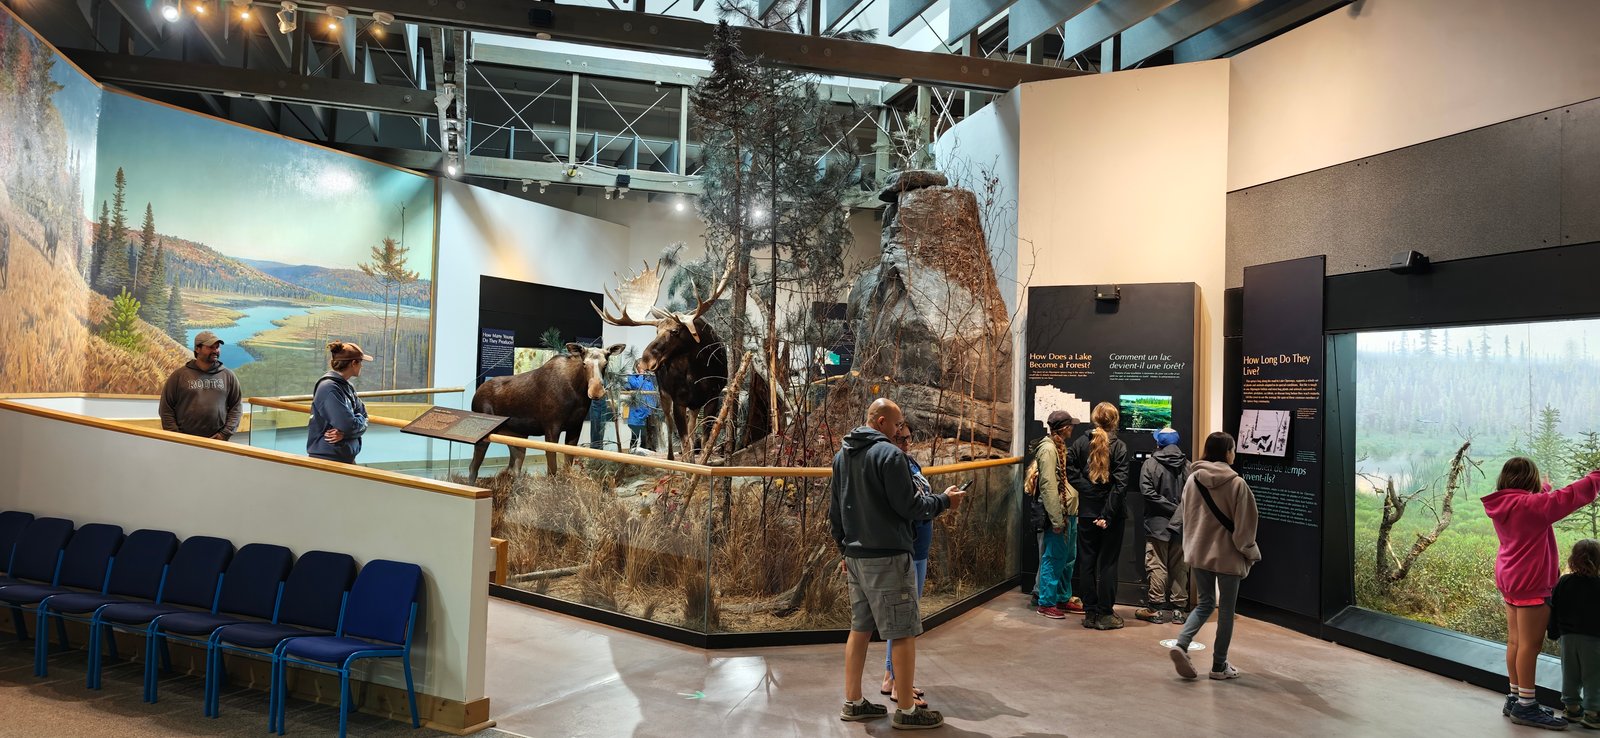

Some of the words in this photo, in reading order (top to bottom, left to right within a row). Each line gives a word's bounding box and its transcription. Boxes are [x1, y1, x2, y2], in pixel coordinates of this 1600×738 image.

[1029, 353, 1048, 361] How
[1049, 353, 1067, 361] Does
[1075, 353, 1092, 361] Lake
[1109, 353, 1146, 361] Comment
[1160, 353, 1172, 361] lac
[1243, 356, 1260, 365] How
[1260, 355, 1278, 366] Long
[1279, 354, 1291, 364] Do
[1292, 353, 1311, 365] They
[1029, 361, 1058, 369] Become
[1065, 361, 1091, 369] Forest?
[1109, 361, 1145, 370] devient-il
[1162, 361, 1186, 370] forêt?
[1243, 366, 1260, 376] Live?
[187, 378, 225, 390] ROOTS
[1284, 465, 1307, 477] temps
[1242, 471, 1276, 484] vivent-ils?
